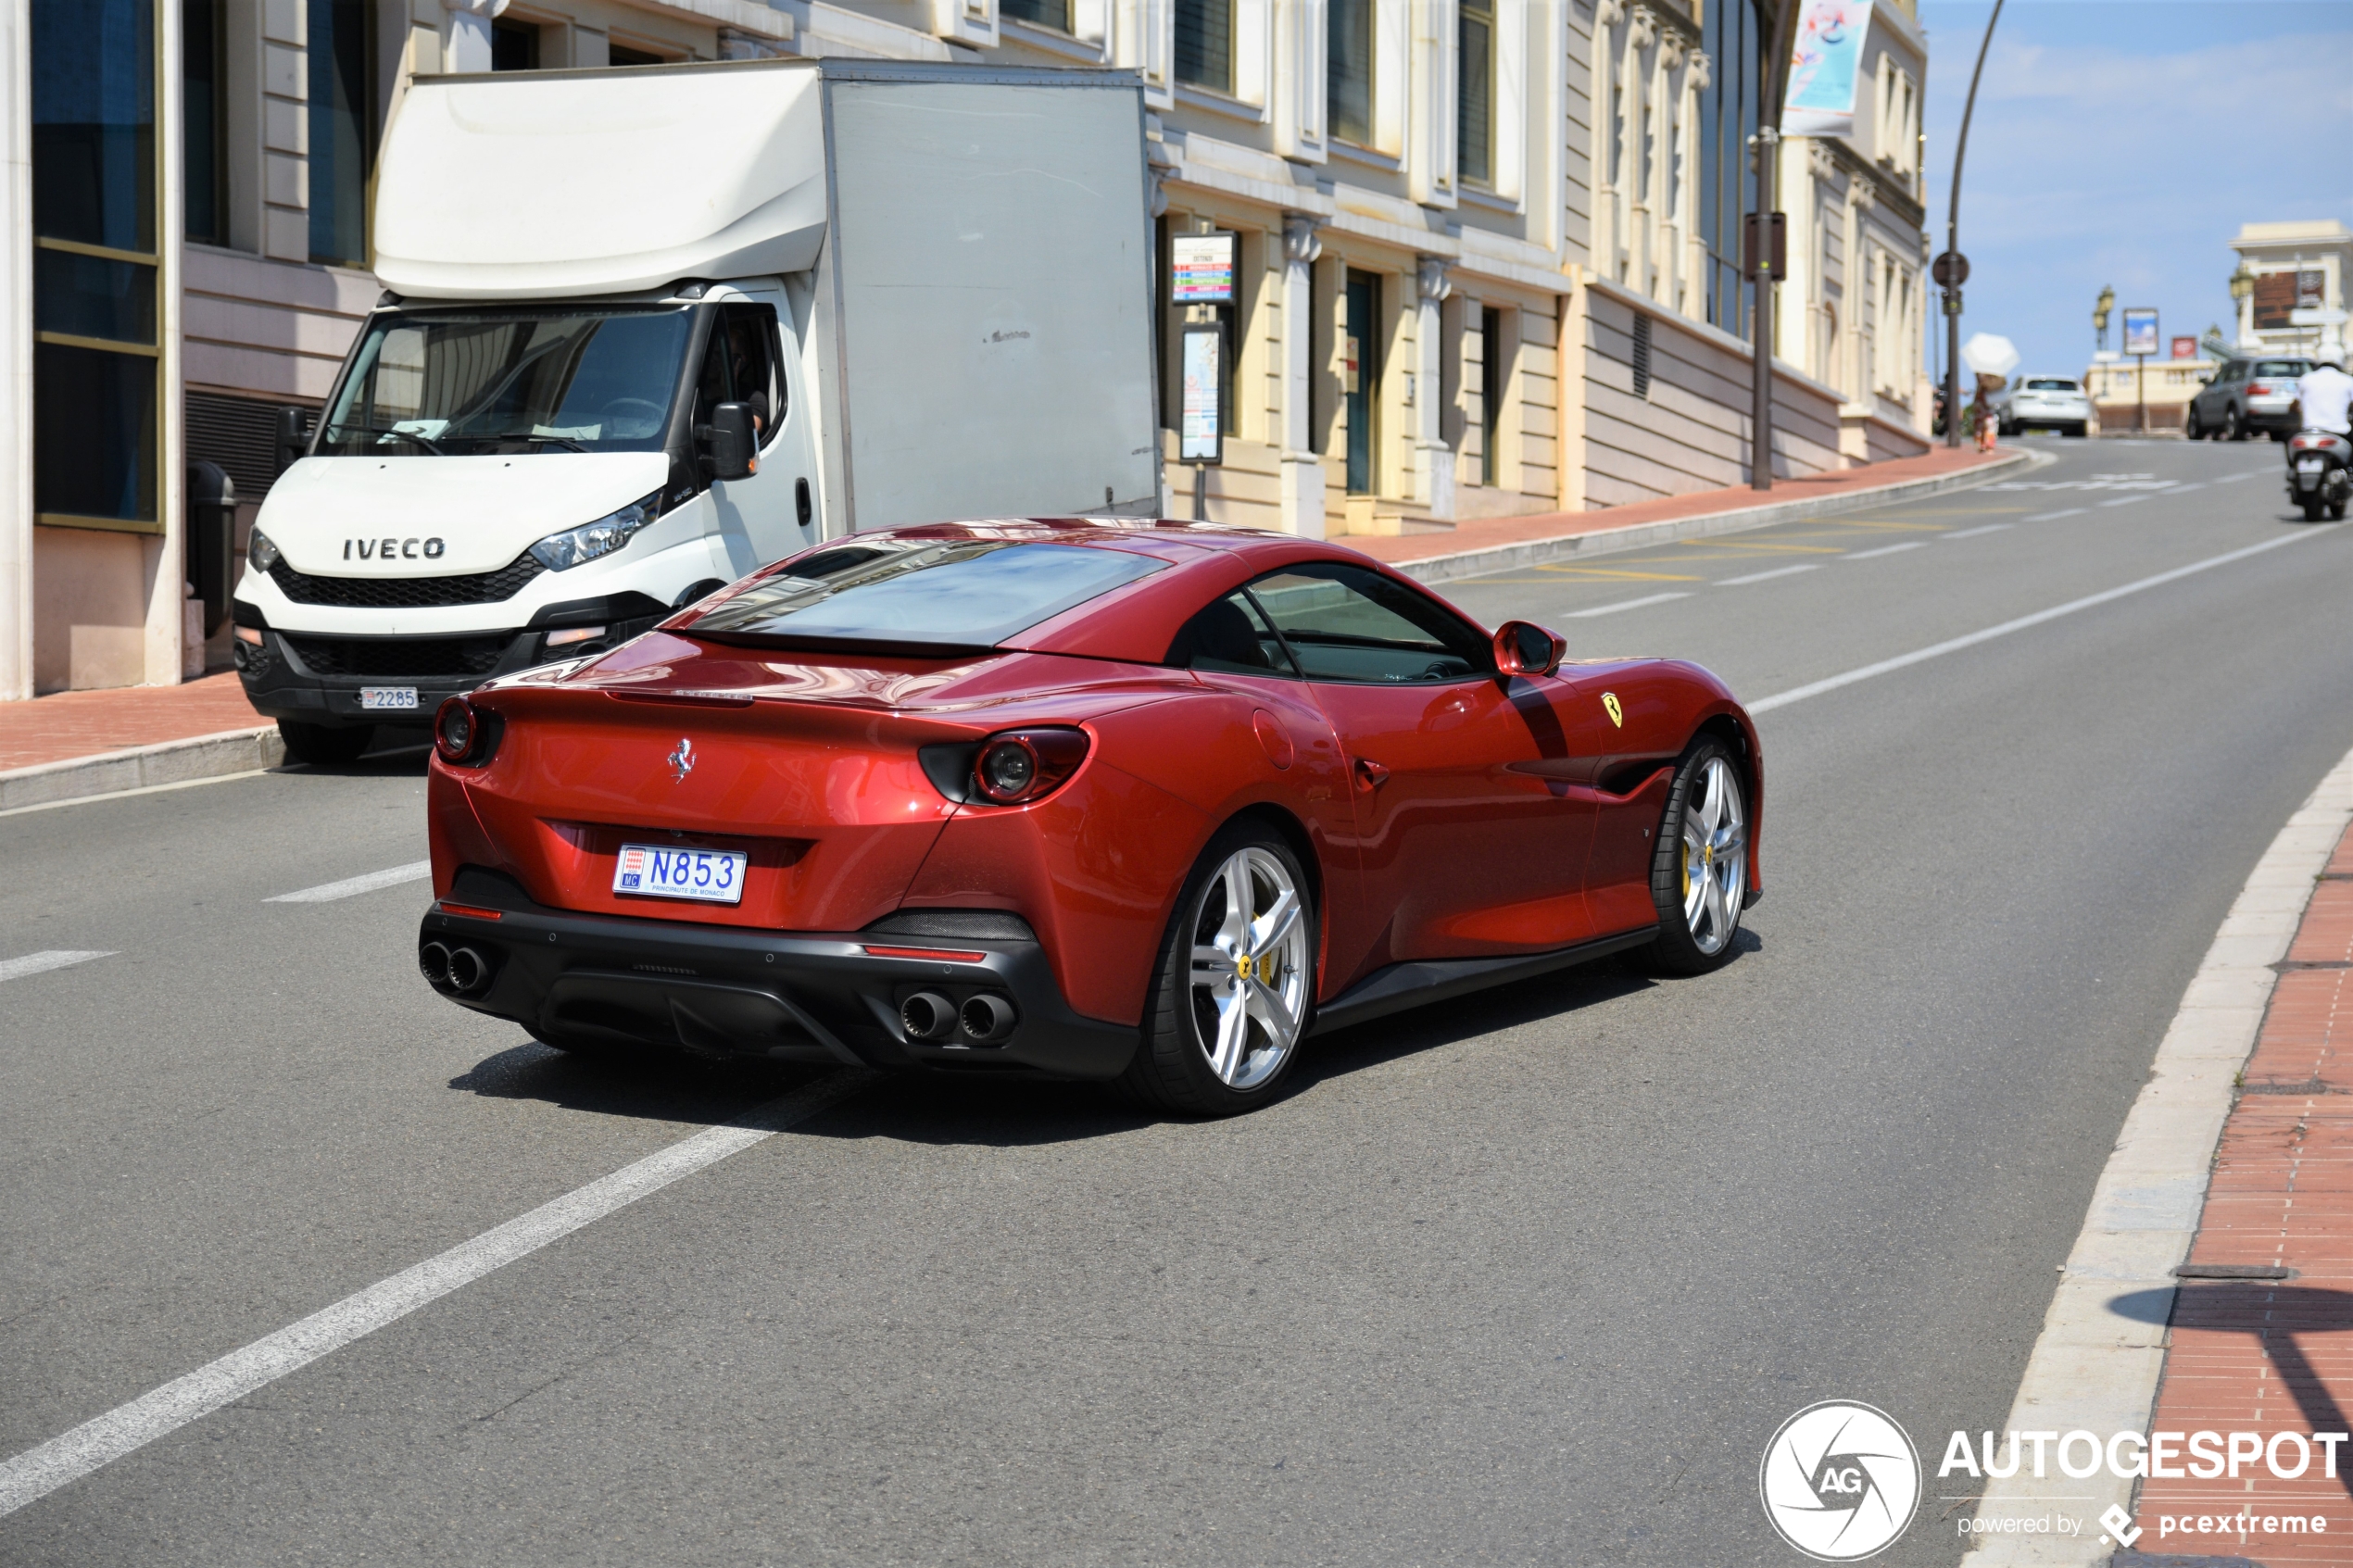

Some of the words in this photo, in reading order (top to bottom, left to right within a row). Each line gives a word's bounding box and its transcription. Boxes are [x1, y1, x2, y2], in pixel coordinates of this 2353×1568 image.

[343, 537, 447, 560] IVECO
[376, 691, 415, 707] 2285
[650, 851, 735, 889] N853
[624, 875, 637, 885] MC
[652, 885, 688, 894] PRINCIPAUTE
